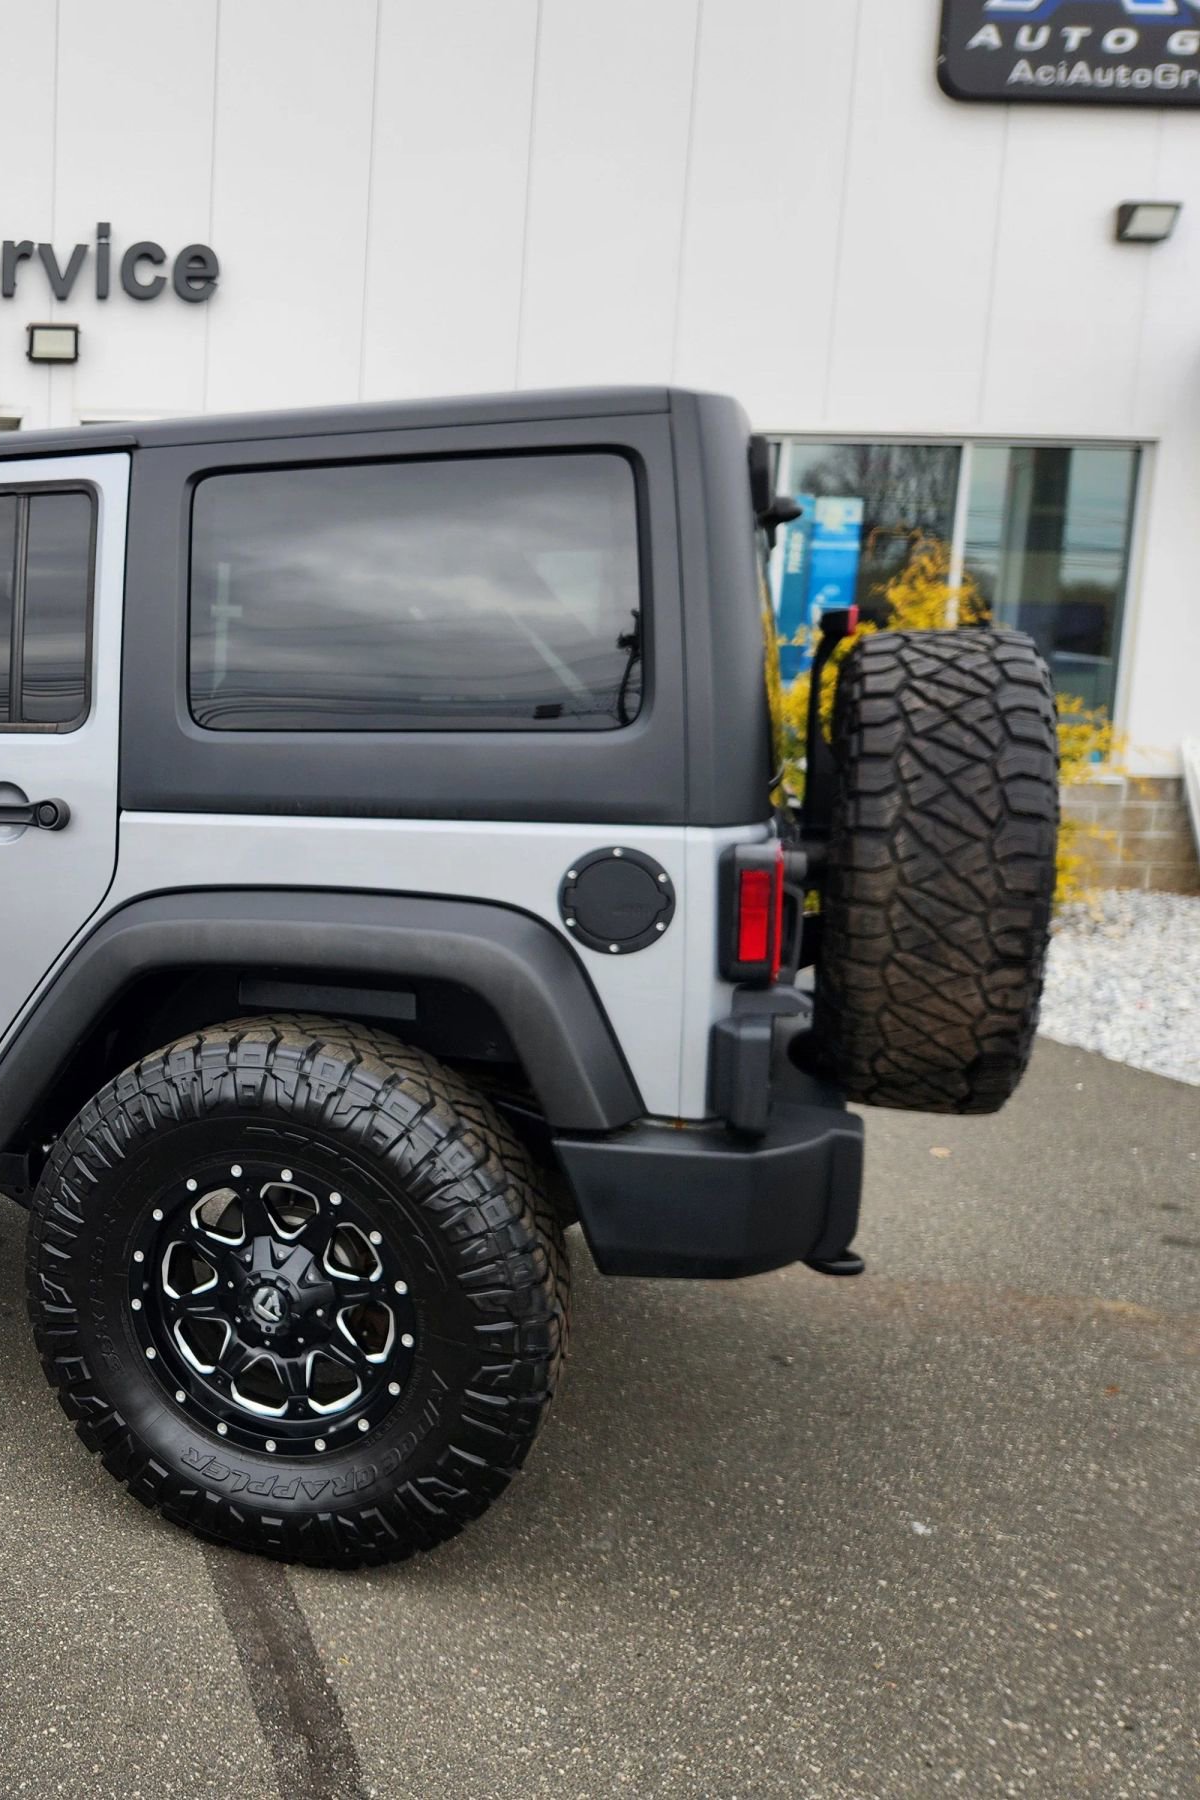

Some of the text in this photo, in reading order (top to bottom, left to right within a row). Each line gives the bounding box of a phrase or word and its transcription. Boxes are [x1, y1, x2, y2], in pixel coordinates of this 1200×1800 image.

[966, 23, 1139, 54] AUTO
[1006, 59, 1200, 90] AciAutoGr
[176, 1446, 378, 1501] GRAPPLER
